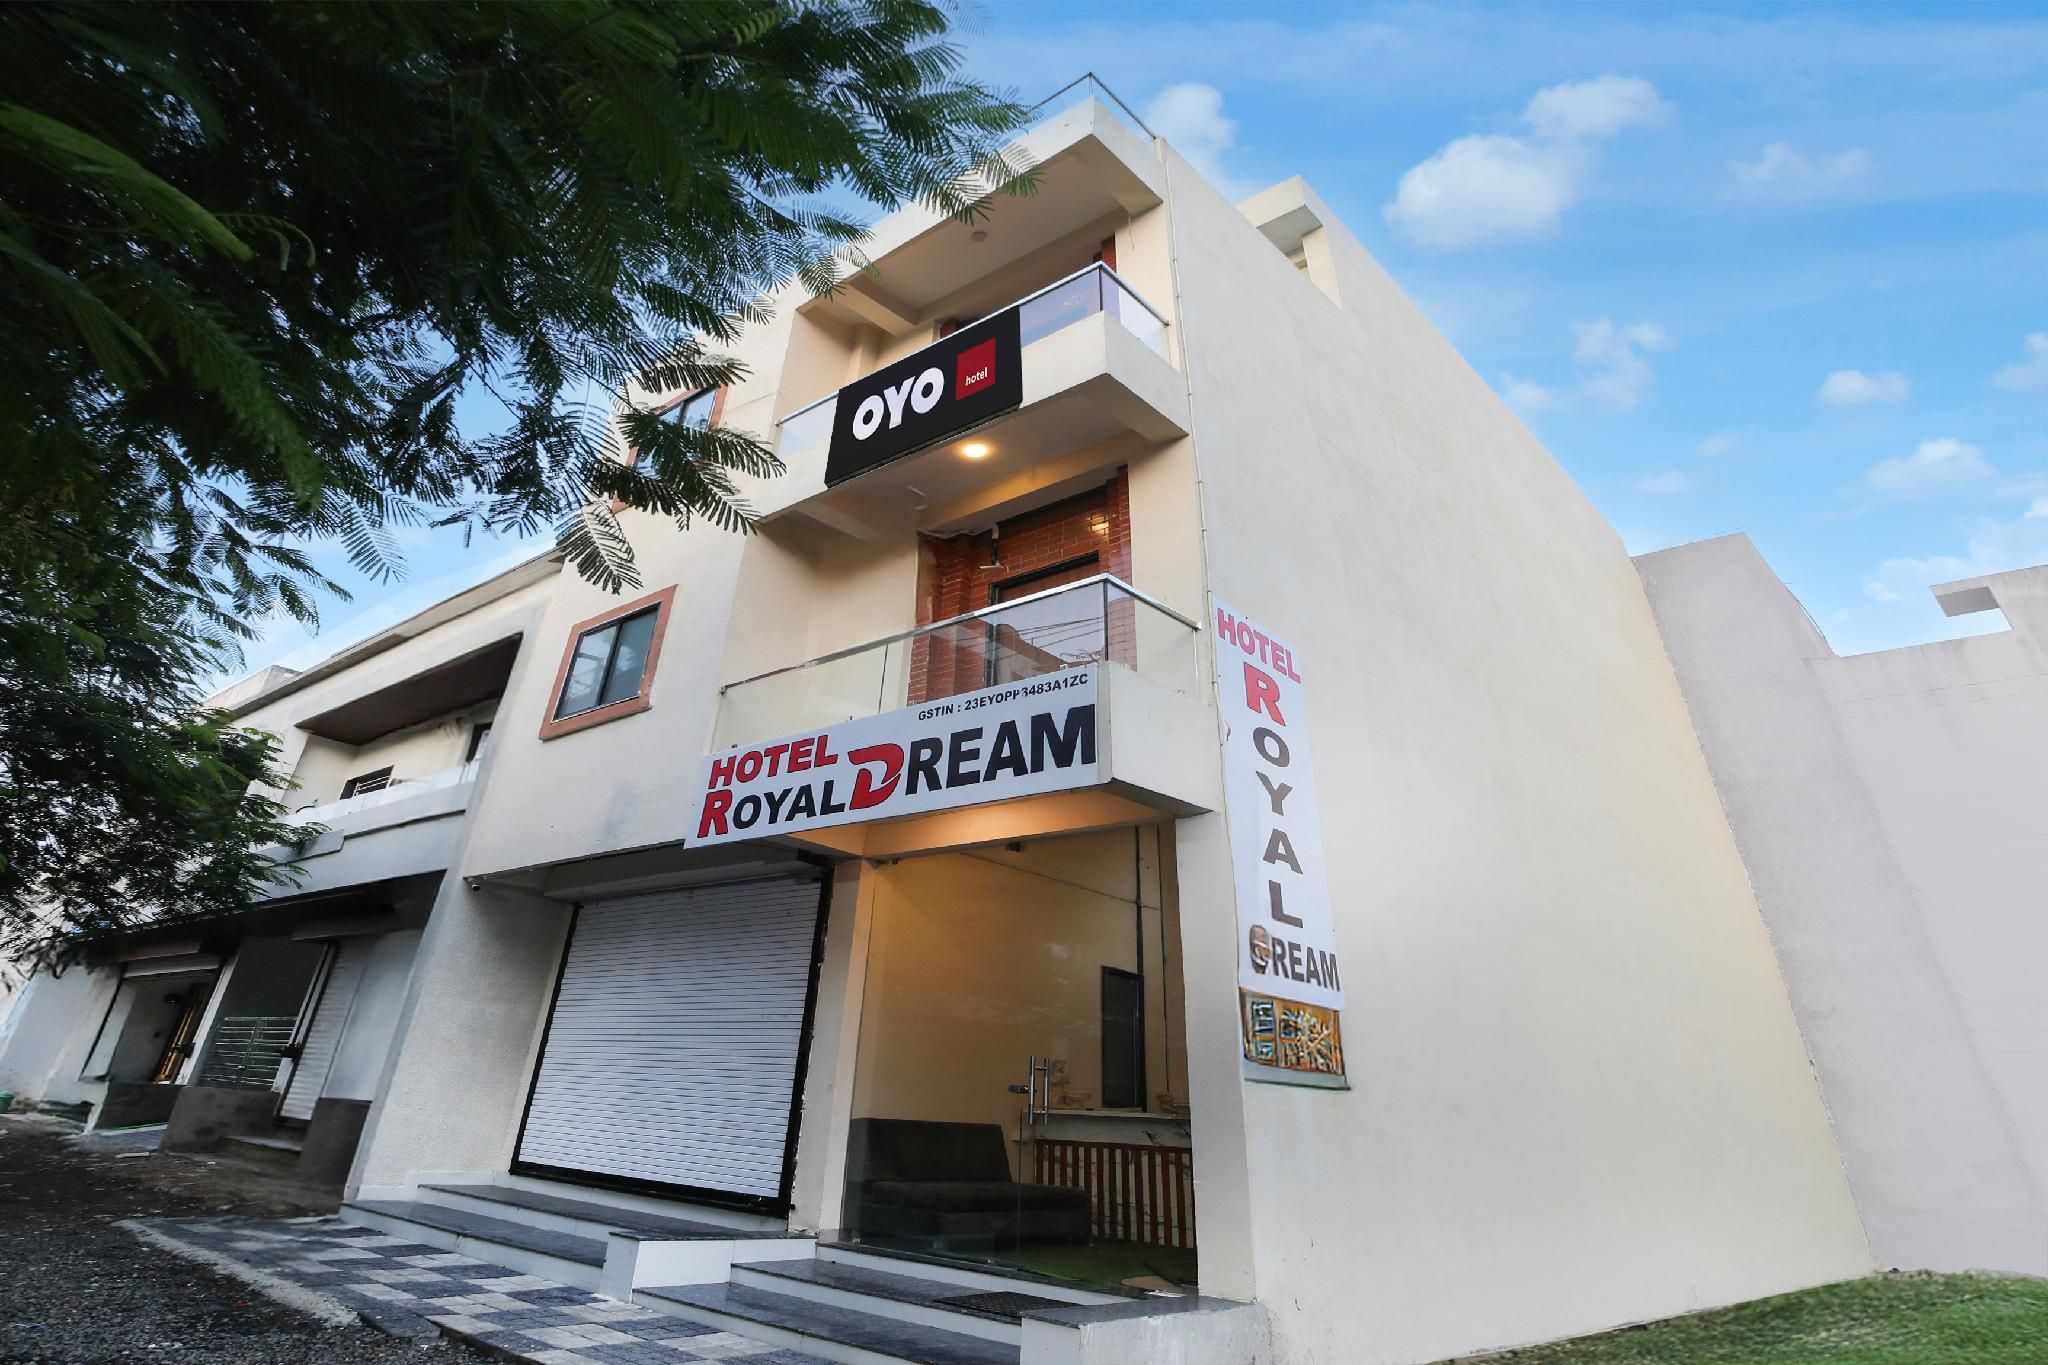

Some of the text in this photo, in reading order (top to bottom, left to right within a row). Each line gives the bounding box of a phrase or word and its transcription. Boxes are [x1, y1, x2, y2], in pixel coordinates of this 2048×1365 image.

[852, 366, 945, 441] OYO
[965, 366, 988, 387] hotel
[1217, 607, 1301, 684] HOTEL
[918, 703, 954, 721] GSTIN
[697, 703, 1097, 838] ROYAL DREAM
[708, 734, 838, 789] HOTEL
[1243, 661, 1304, 928] ROYAL
